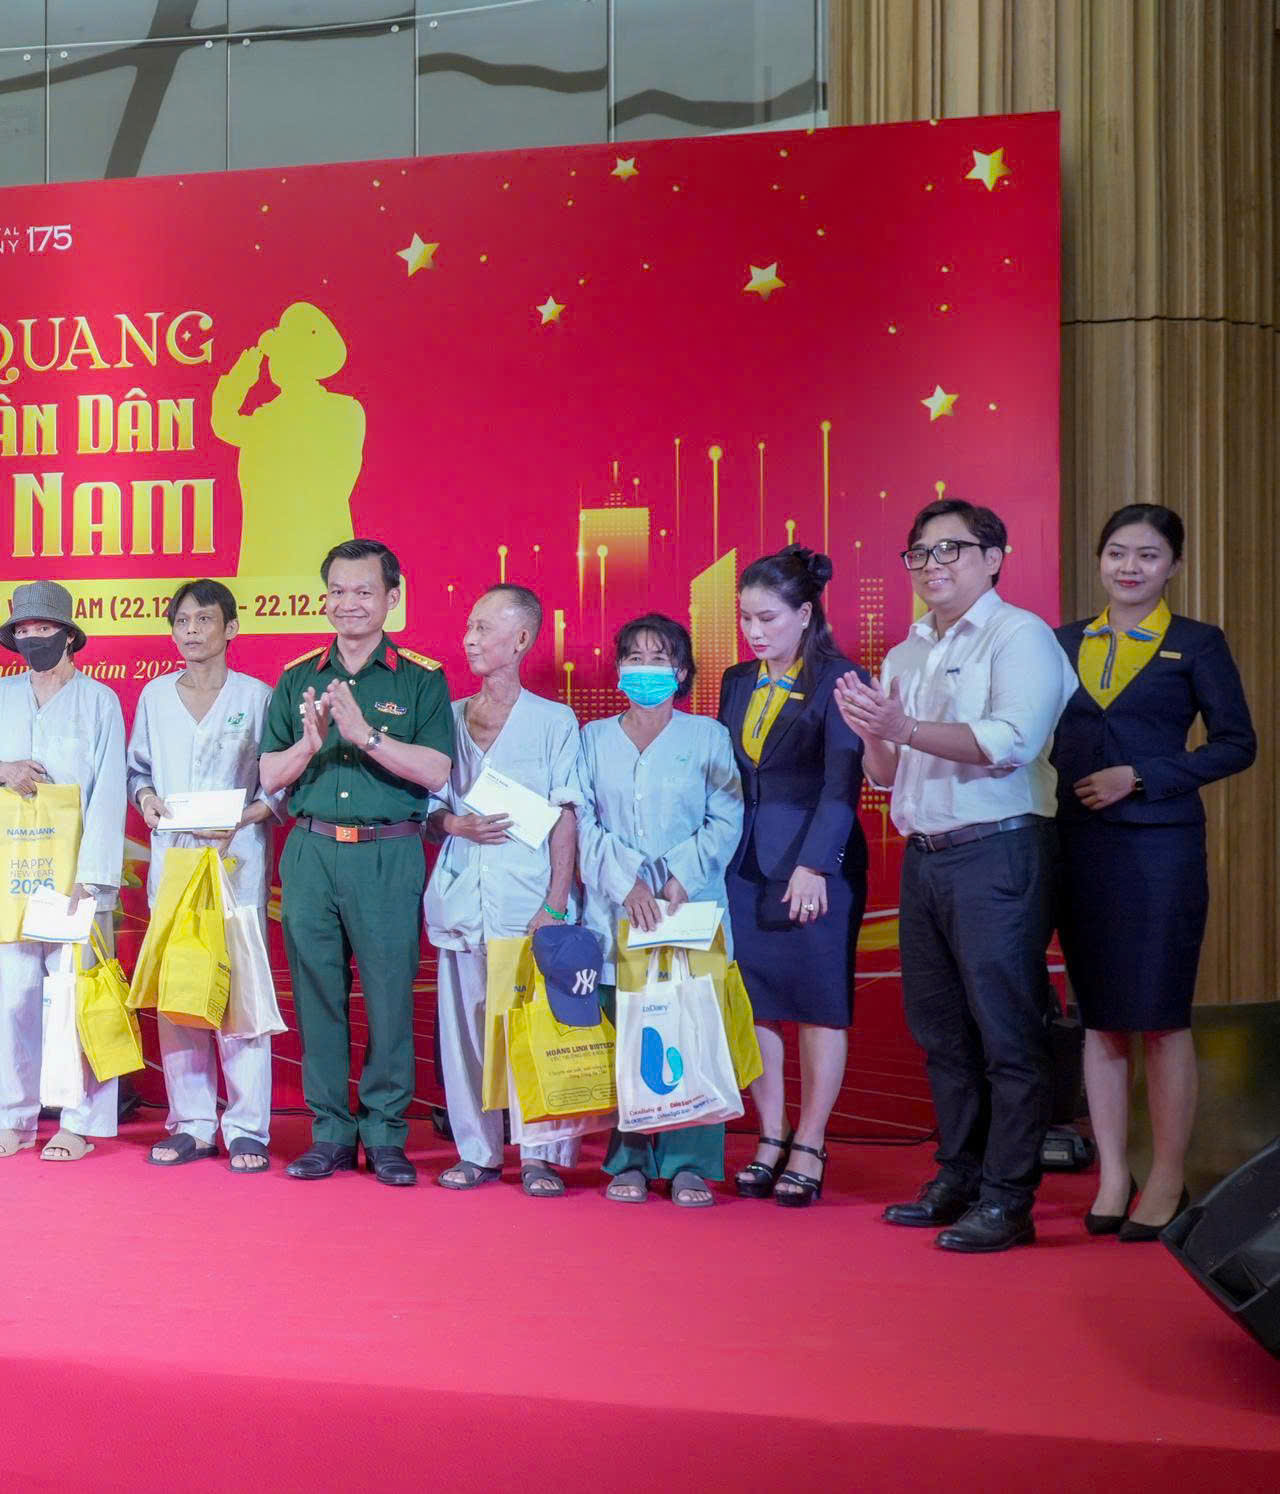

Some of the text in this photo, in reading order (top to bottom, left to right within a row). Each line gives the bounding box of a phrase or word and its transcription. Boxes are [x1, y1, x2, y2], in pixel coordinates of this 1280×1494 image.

[8, 240, 20, 253] Y
[26, 224, 73, 253] 175
[76, 386, 196, 455] DÂN
[10, 472, 216, 559] NAM
[74, 597, 103, 619] AM
[82, 659, 127, 680] năm
[10, 856, 54, 870] HAPPY
[10, 877, 56, 895] 2026
